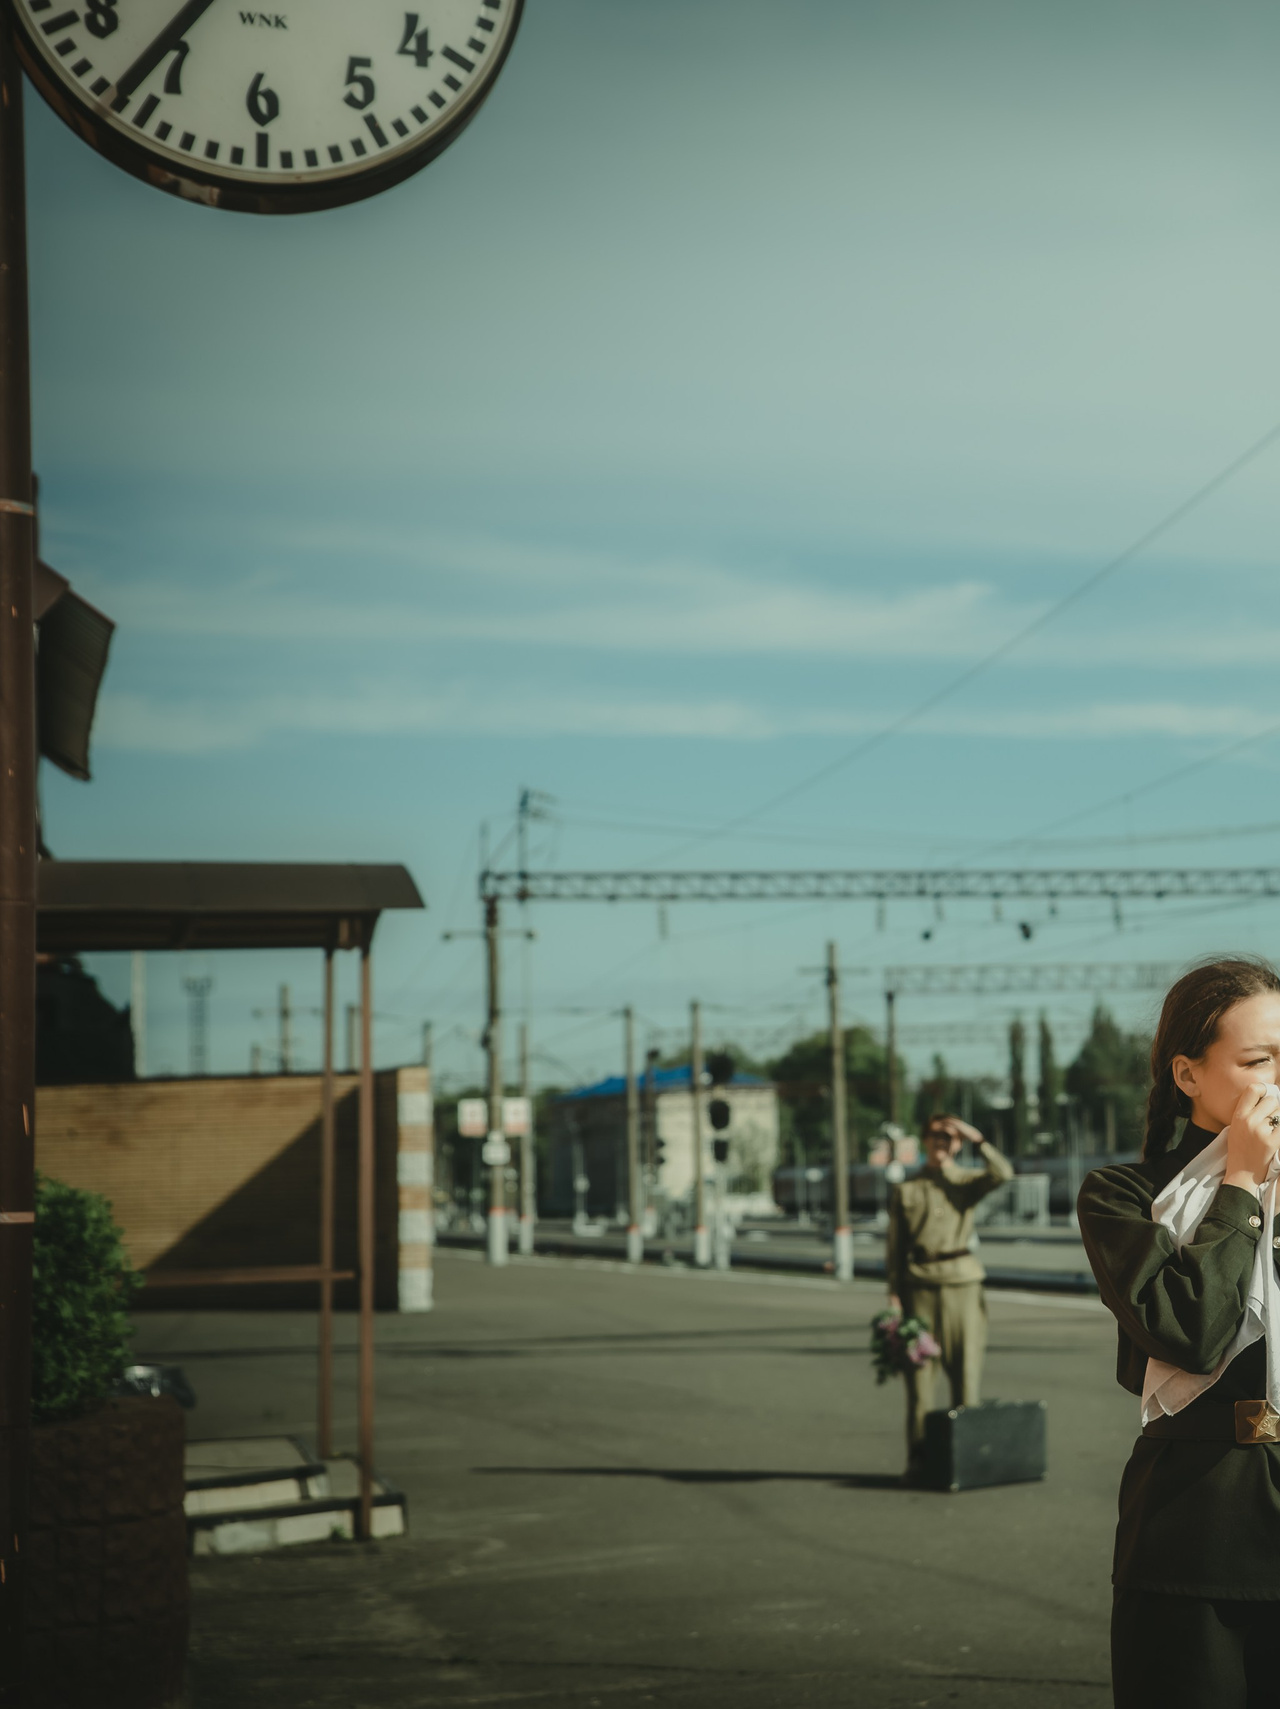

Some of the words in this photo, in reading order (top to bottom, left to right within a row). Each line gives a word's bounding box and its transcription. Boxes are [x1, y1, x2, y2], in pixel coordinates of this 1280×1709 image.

[238, 11, 289, 30] WNK
[397, 12, 433, 68] 4
[163, 39, 190, 94] 7
[343, 55, 375, 110] 5
[246, 72, 279, 127] 6
